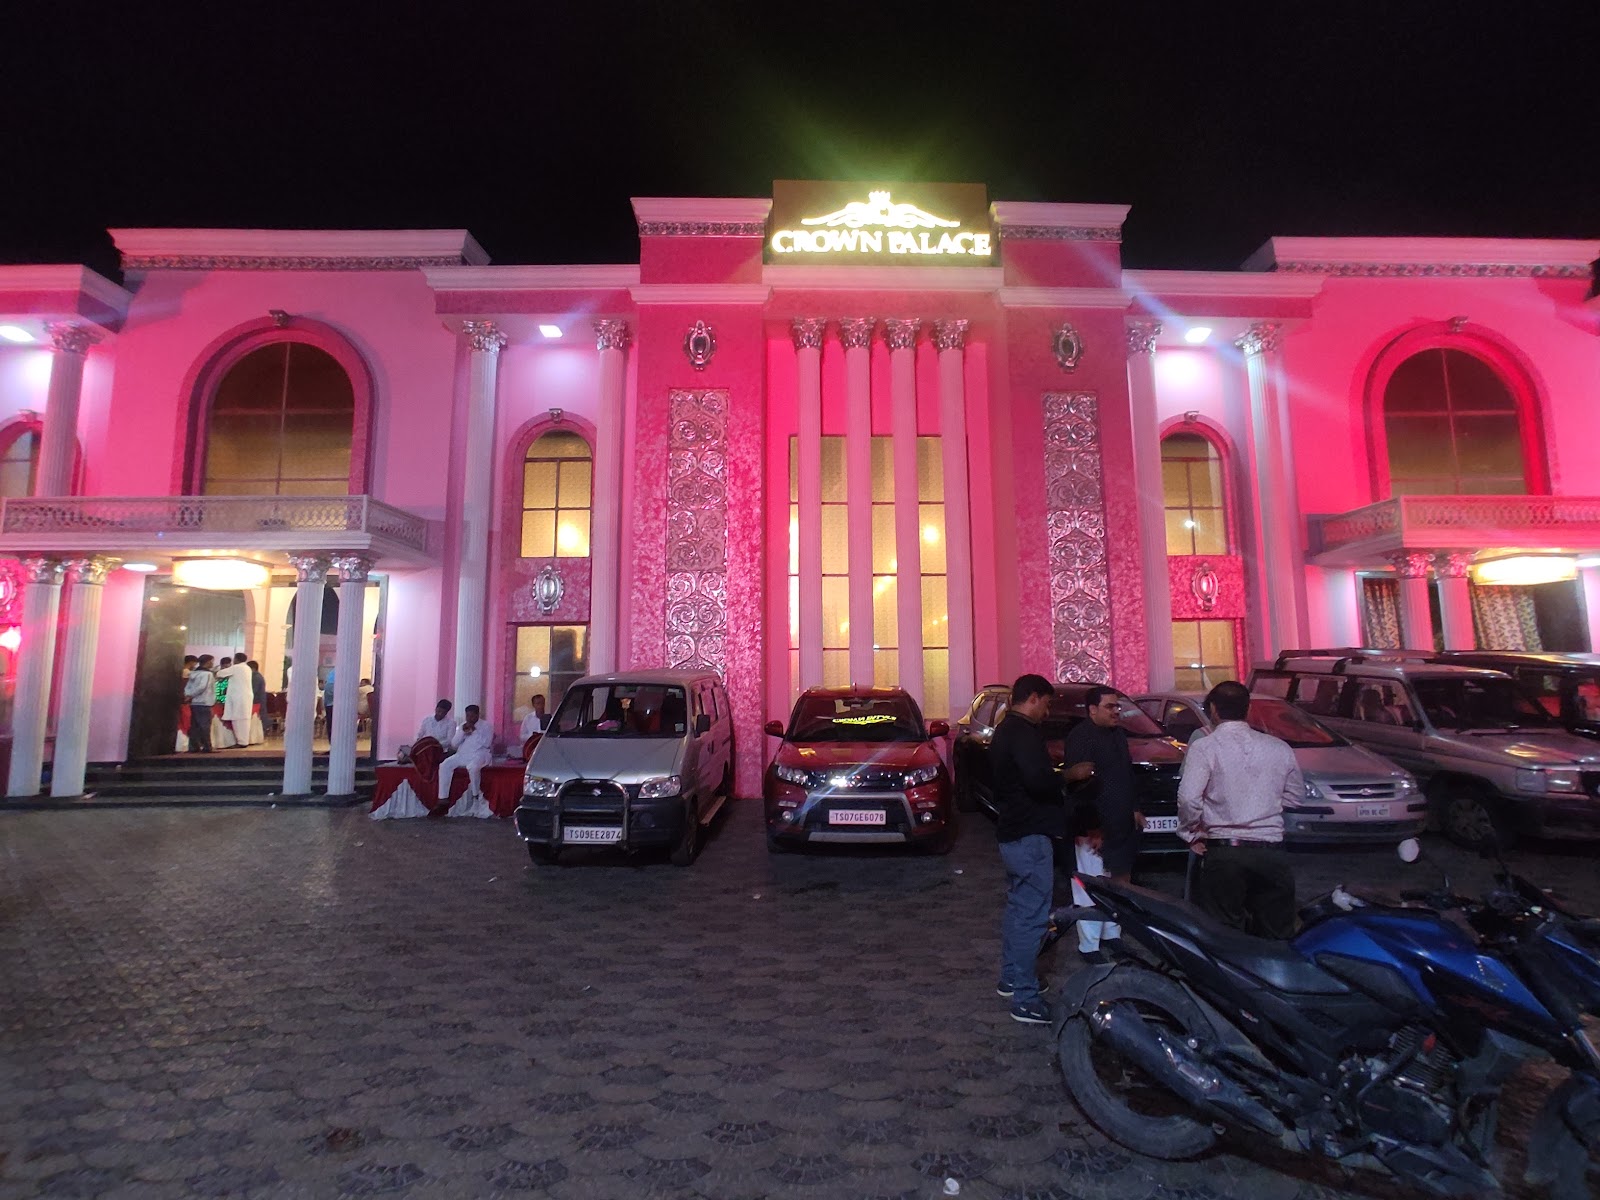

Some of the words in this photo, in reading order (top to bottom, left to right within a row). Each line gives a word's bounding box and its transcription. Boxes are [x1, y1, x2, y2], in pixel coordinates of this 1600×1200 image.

[771, 229, 883, 253] CROWN
[887, 231, 992, 256] PALACE
[1146, 819, 1178, 830] S13ET9
